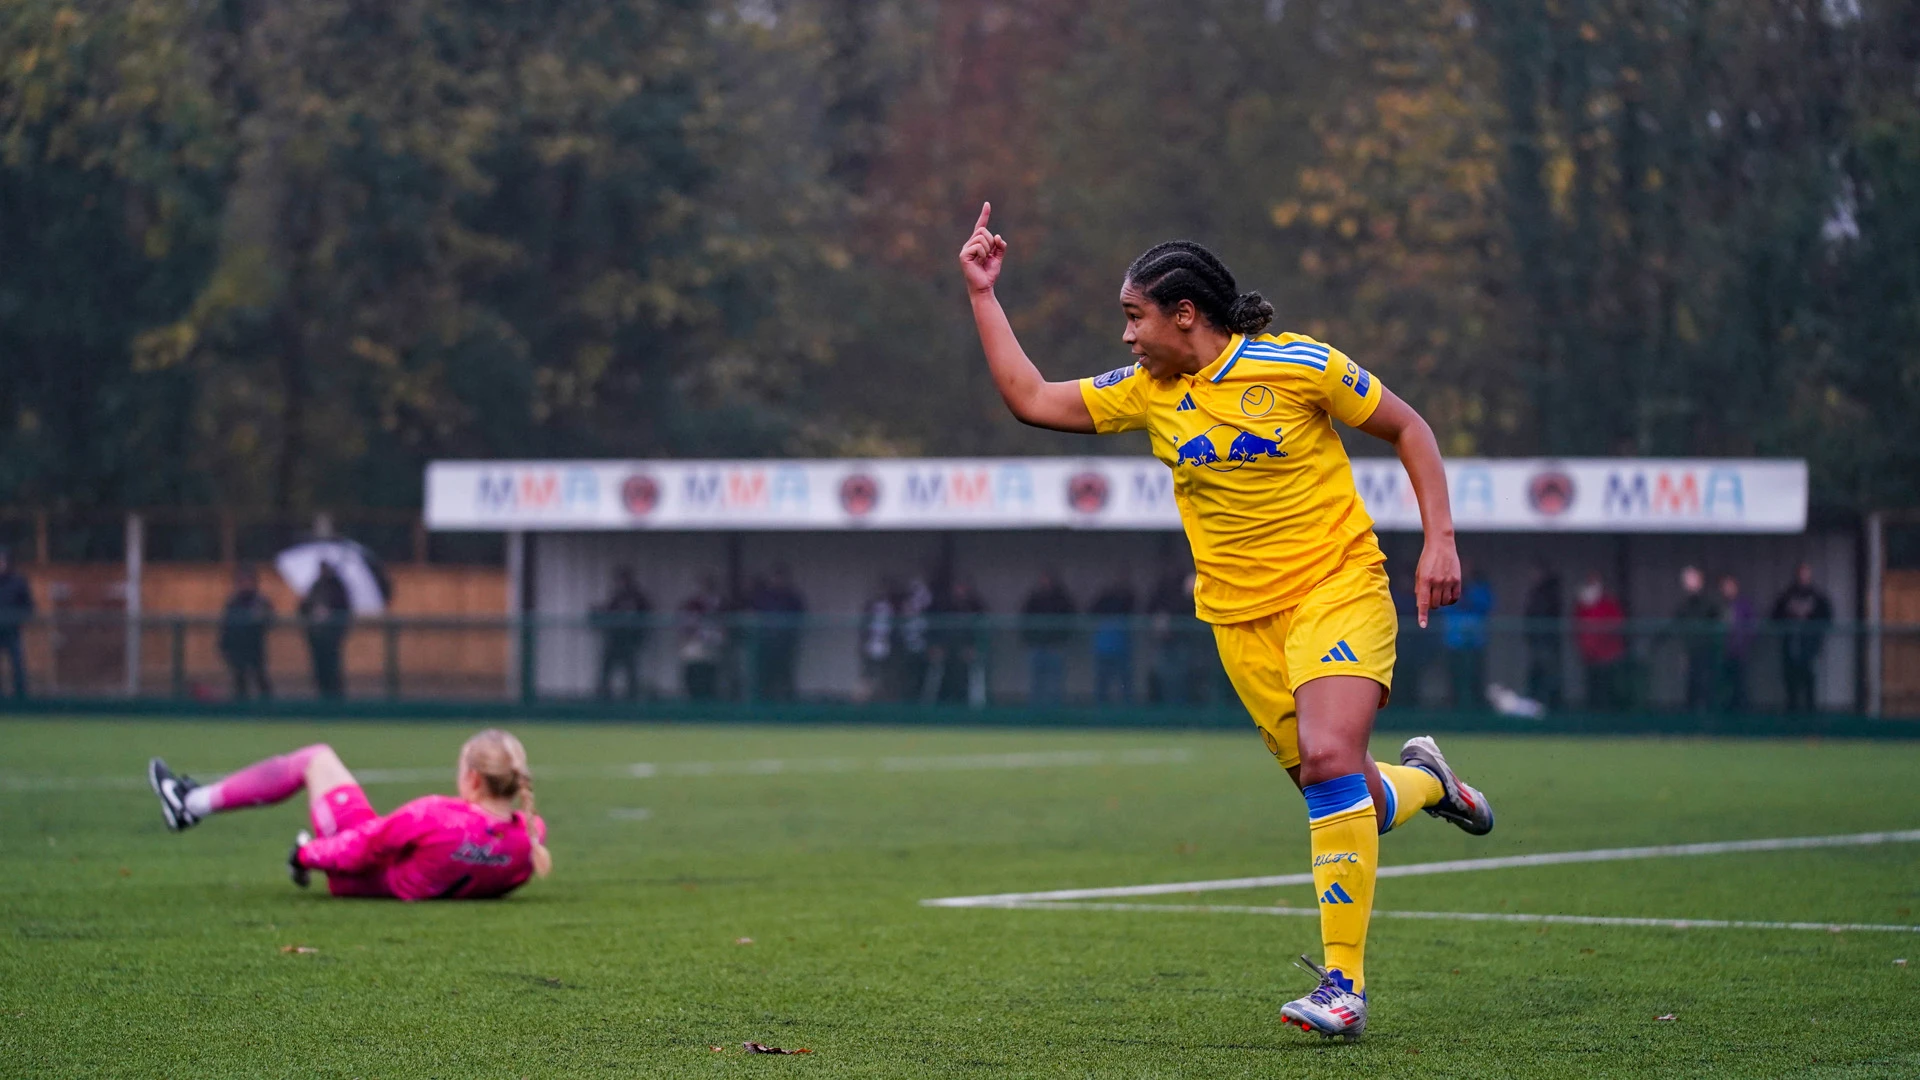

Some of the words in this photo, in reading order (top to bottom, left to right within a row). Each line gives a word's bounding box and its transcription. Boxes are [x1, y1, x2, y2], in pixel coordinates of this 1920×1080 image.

[1341, 362, 1357, 388] BO
[476, 466, 599, 511] MMA
[682, 465, 810, 510] MMA
[904, 464, 1034, 510] MMA
[1358, 465, 1495, 513] MA
[1602, 468, 1745, 516] MMA
